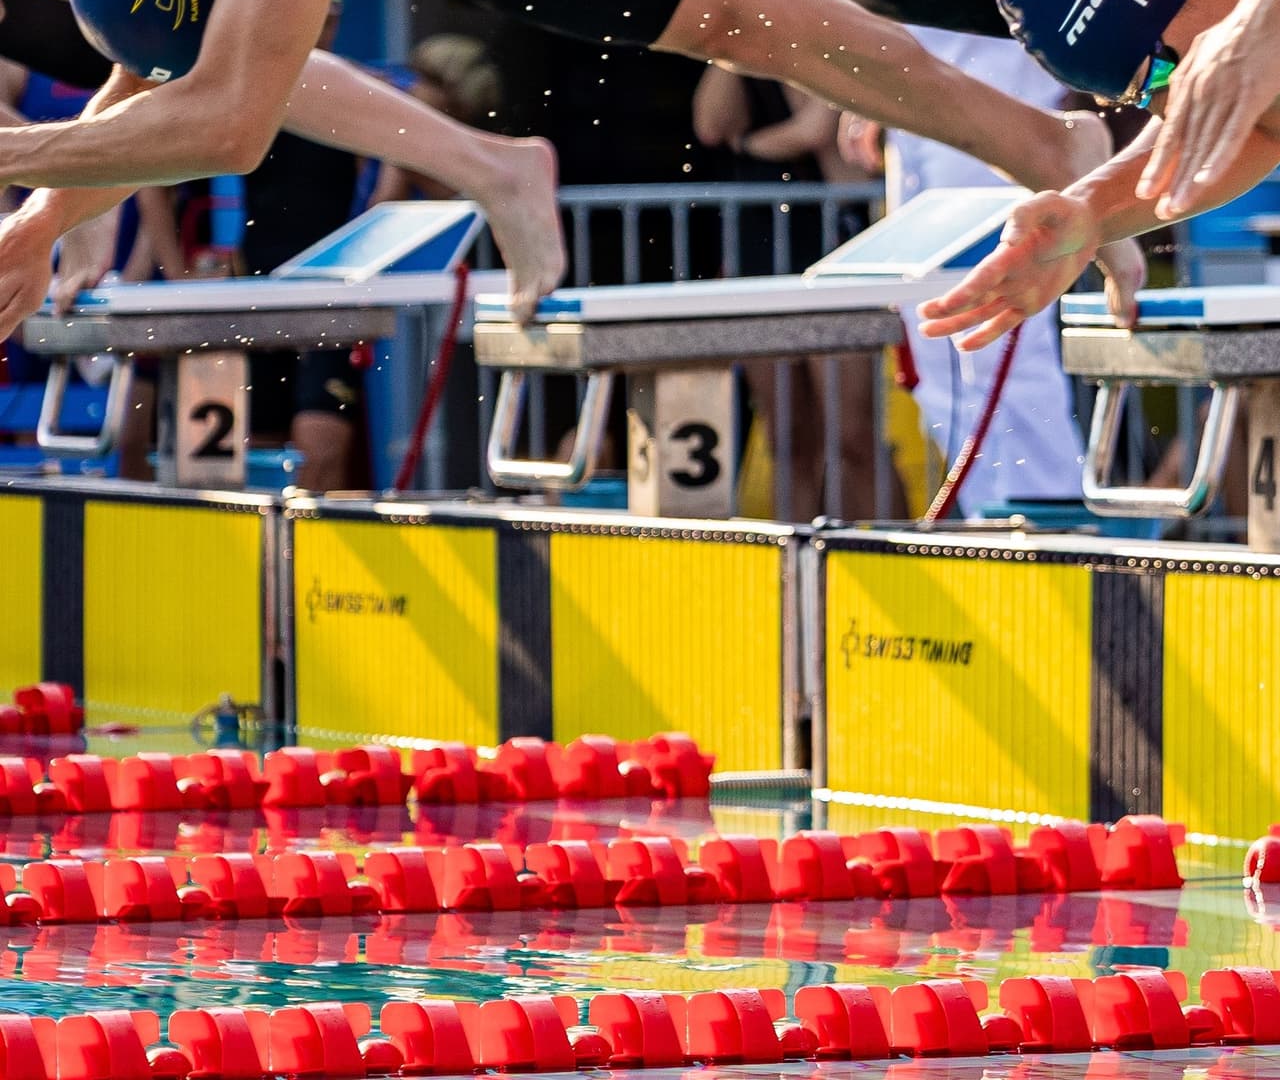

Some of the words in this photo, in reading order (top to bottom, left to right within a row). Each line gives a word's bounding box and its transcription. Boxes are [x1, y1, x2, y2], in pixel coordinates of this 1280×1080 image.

[189, 402, 235, 459] 2
[669, 422, 721, 489] 3
[1253, 436, 1277, 511] 4
